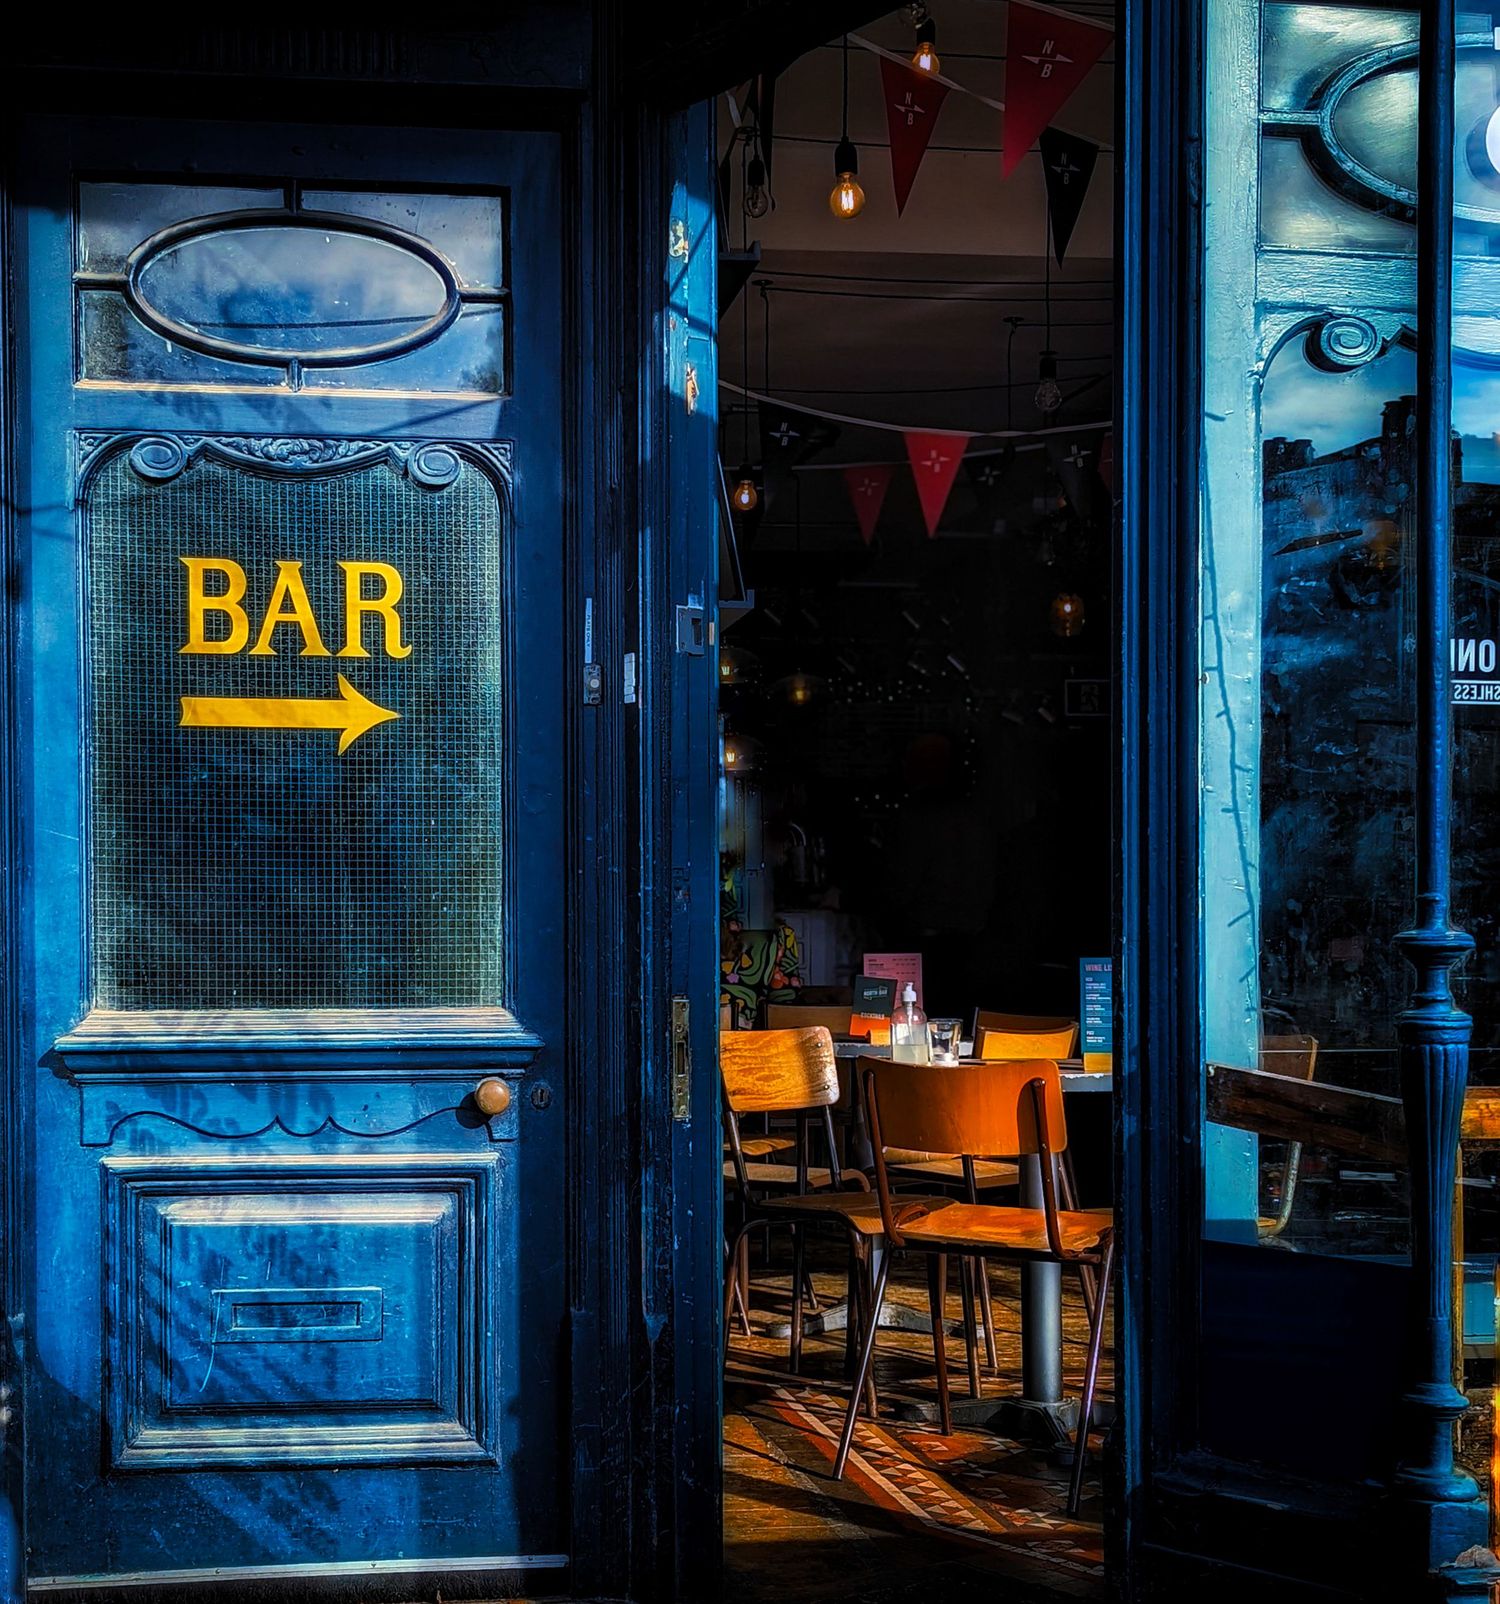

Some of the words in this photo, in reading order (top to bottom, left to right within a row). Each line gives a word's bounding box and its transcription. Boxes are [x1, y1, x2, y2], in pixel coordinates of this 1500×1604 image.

[1041, 39, 1054, 55] N
[1040, 63, 1053, 79] B
[904, 92, 912, 105] N
[906, 112, 914, 126] B
[1060, 152, 1067, 165] N
[180, 557, 412, 659] BAR
